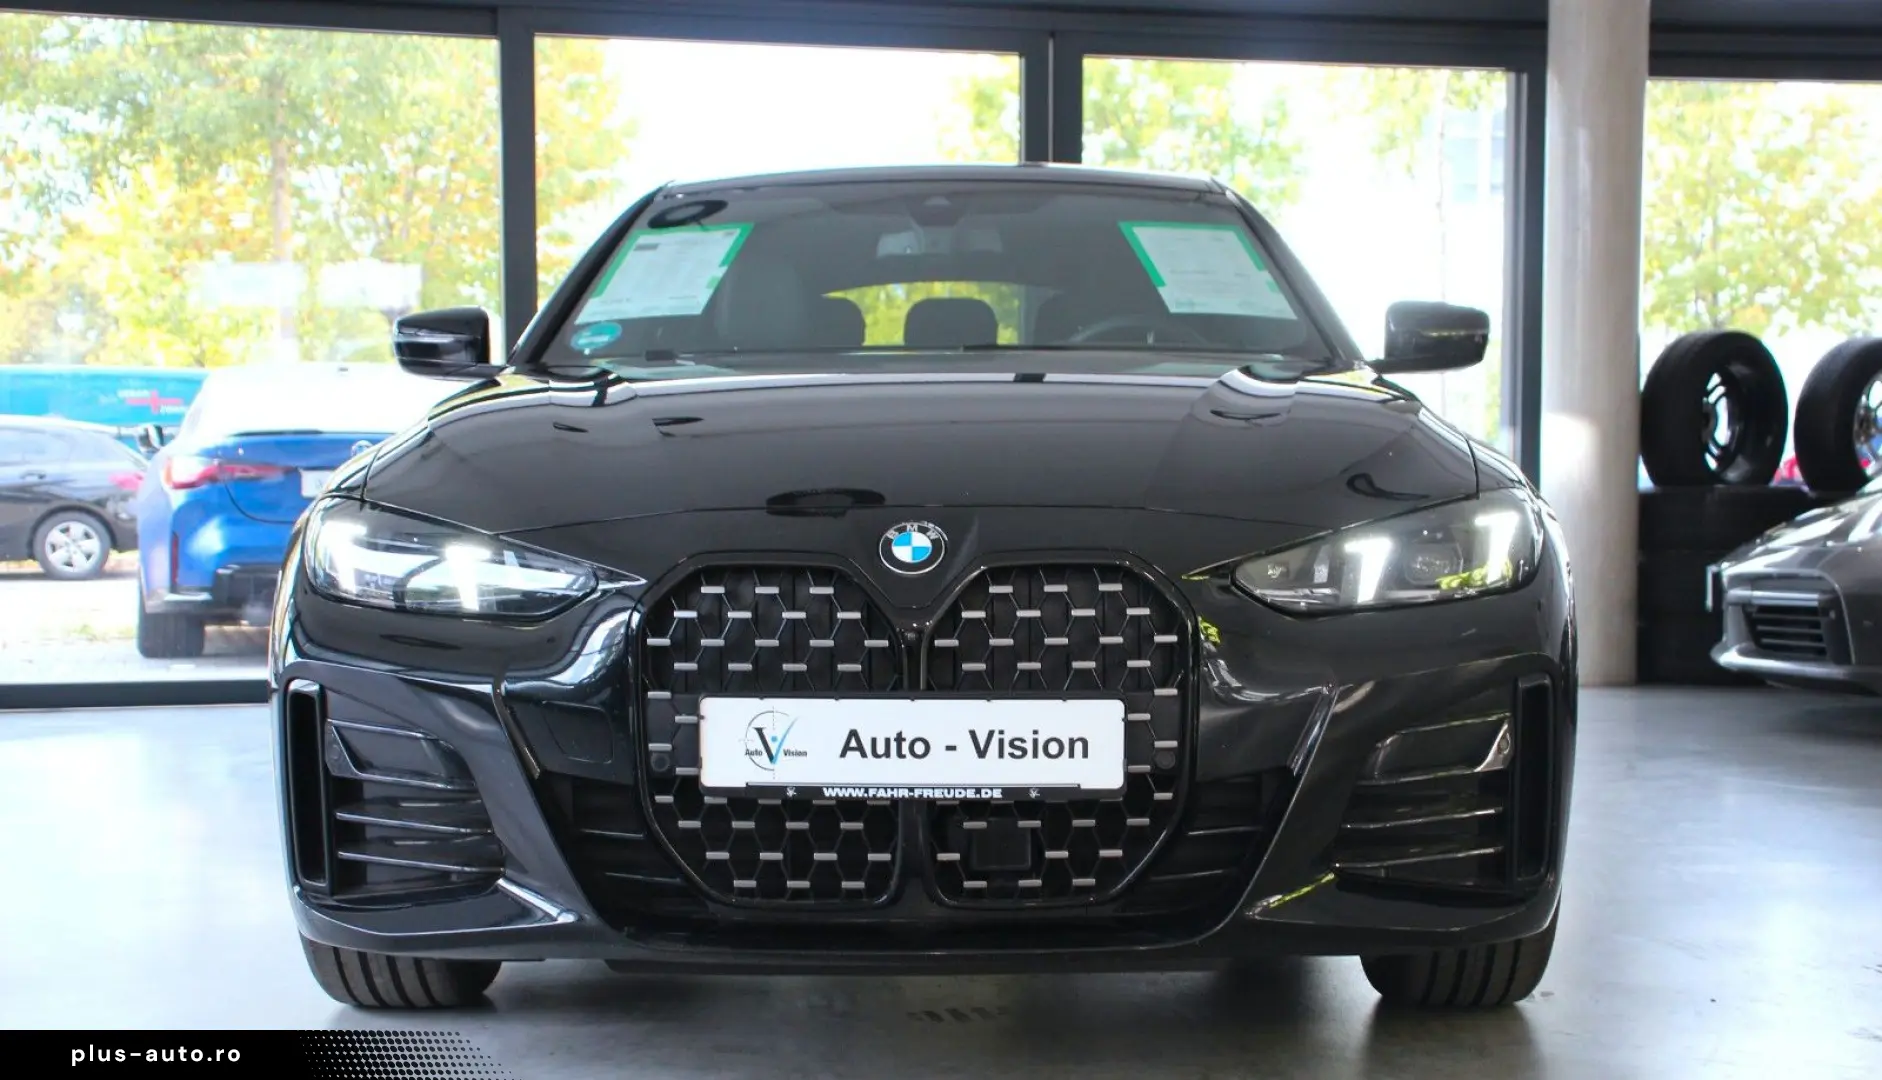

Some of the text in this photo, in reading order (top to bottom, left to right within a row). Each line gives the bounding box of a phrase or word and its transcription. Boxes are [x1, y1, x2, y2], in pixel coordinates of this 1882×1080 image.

[886, 523, 940, 540] BMW
[839, 728, 931, 760] Auto
[968, 728, 1089, 760] Vision
[745, 748, 807, 757] Auto Vision
[822, 786, 1003, 799] WWW.FAHR-FREUDE.DE
